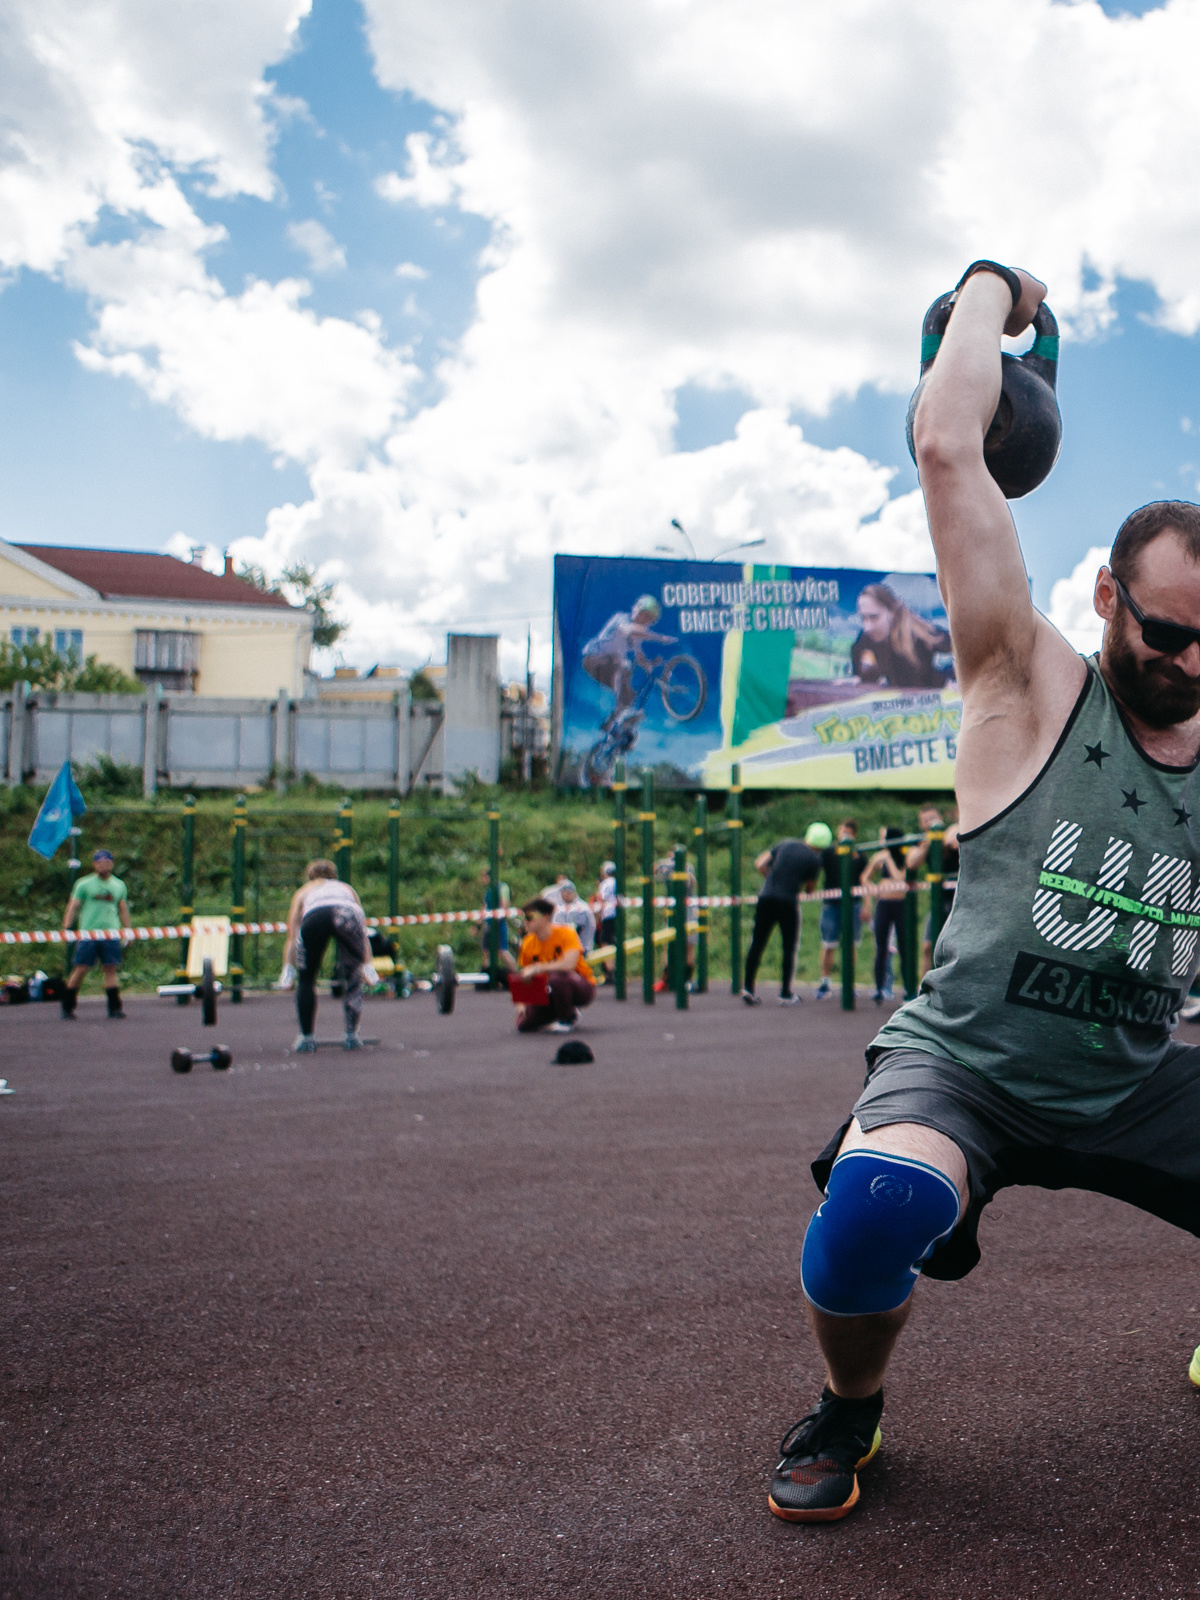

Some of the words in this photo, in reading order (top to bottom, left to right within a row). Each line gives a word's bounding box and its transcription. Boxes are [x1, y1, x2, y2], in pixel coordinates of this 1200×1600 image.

[663, 576, 840, 607] СОВЕРШЕНСТВУЙСЯ
[680, 608, 752, 634] ВМЕСТЕ
[813, 708, 961, 745] ГОРИЗОНТ
[855, 736, 938, 773] ВМЕСТЕ
